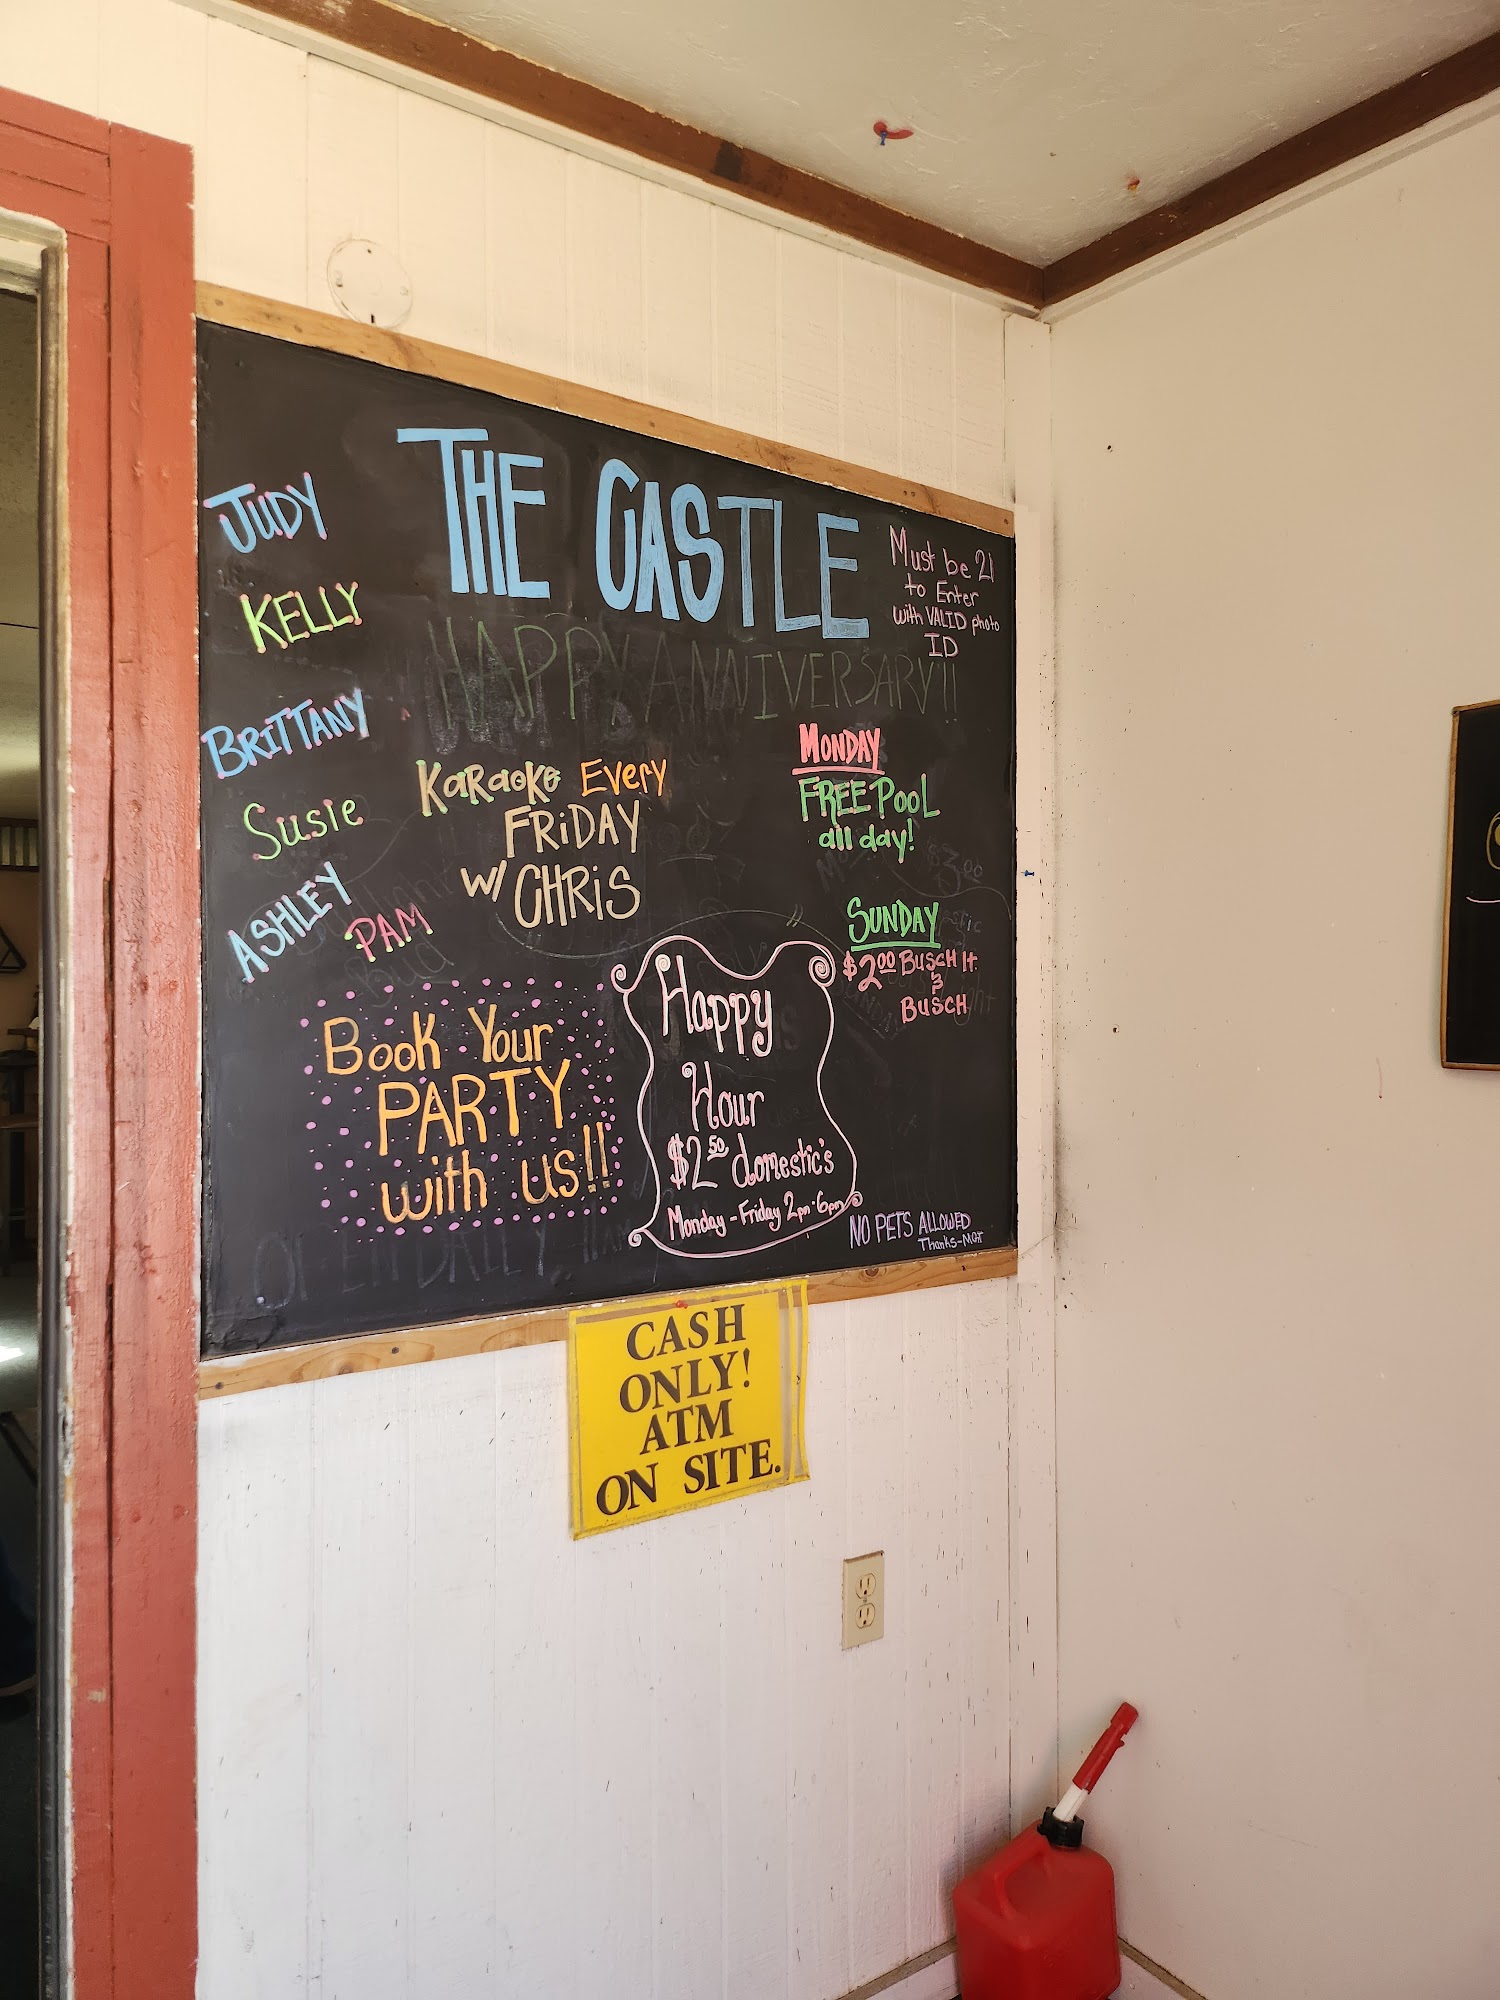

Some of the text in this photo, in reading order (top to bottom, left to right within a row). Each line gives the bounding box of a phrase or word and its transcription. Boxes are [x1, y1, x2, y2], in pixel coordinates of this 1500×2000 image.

[397, 428, 550, 599] THE
[889, 525, 994, 583] Must be 21
[239, 581, 363, 654] KELLY
[904, 572, 979, 607] to Enter
[892, 604, 1000, 636] with VALID photo
[924, 632, 959, 658] ID
[798, 776, 871, 829] FREE
[818, 825, 853, 851] all
[228, 861, 352, 984] ASHLEY
[344, 902, 434, 962] PAM
[468, 1003, 554, 1064] Your
[655, 953, 773, 1057] Happy
[378, 1058, 571, 1156] PARTY
[682, 1060, 765, 1131] Hour
[381, 1149, 488, 1223] with
[850, 1210, 972, 1249] NO PETS ALLOWED
[626, 1303, 746, 1361] CASH
[619, 1347, 751, 1414] ONLY!
[639, 1398, 734, 1456] ATM
[596, 1438, 782, 1516] ON SITE.
